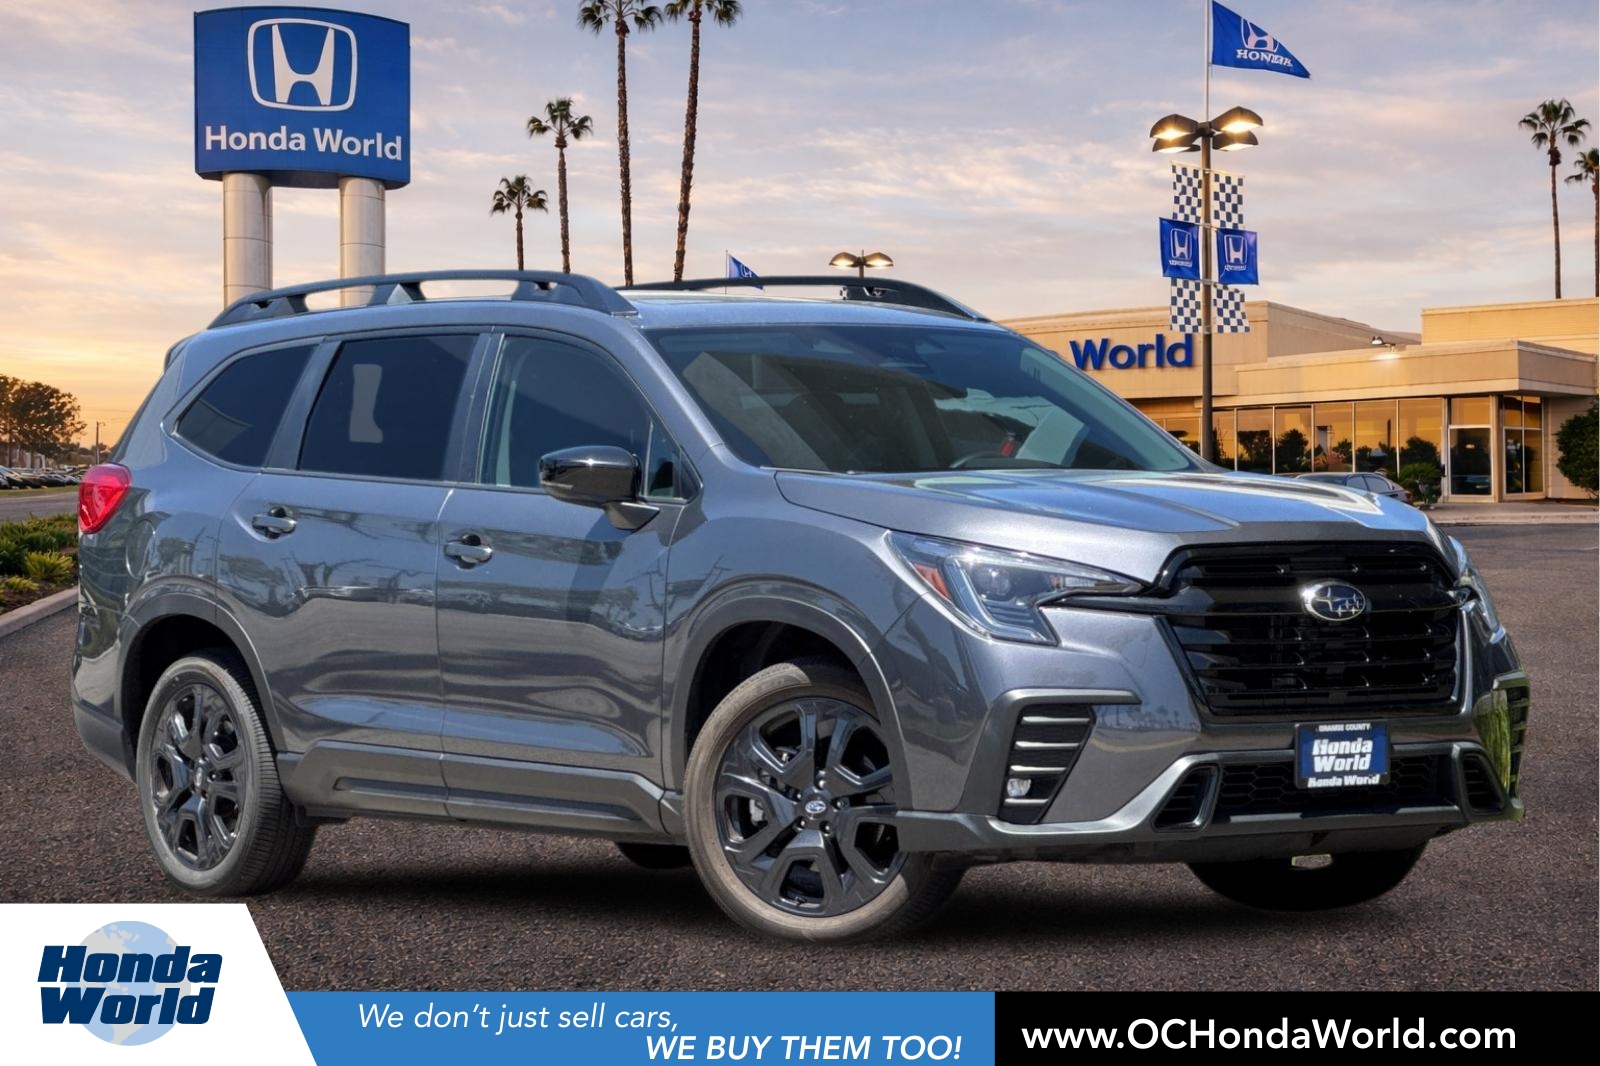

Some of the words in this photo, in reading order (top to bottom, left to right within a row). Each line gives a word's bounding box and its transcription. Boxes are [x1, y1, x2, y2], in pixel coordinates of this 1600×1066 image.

[205, 125, 306, 151] Honda
[312, 127, 402, 161] World
[1069, 333, 1193, 371] World
[1312, 737, 1373, 756] Honda
[1313, 753, 1371, 773] World
[1307, 776, 1342, 788] Honda
